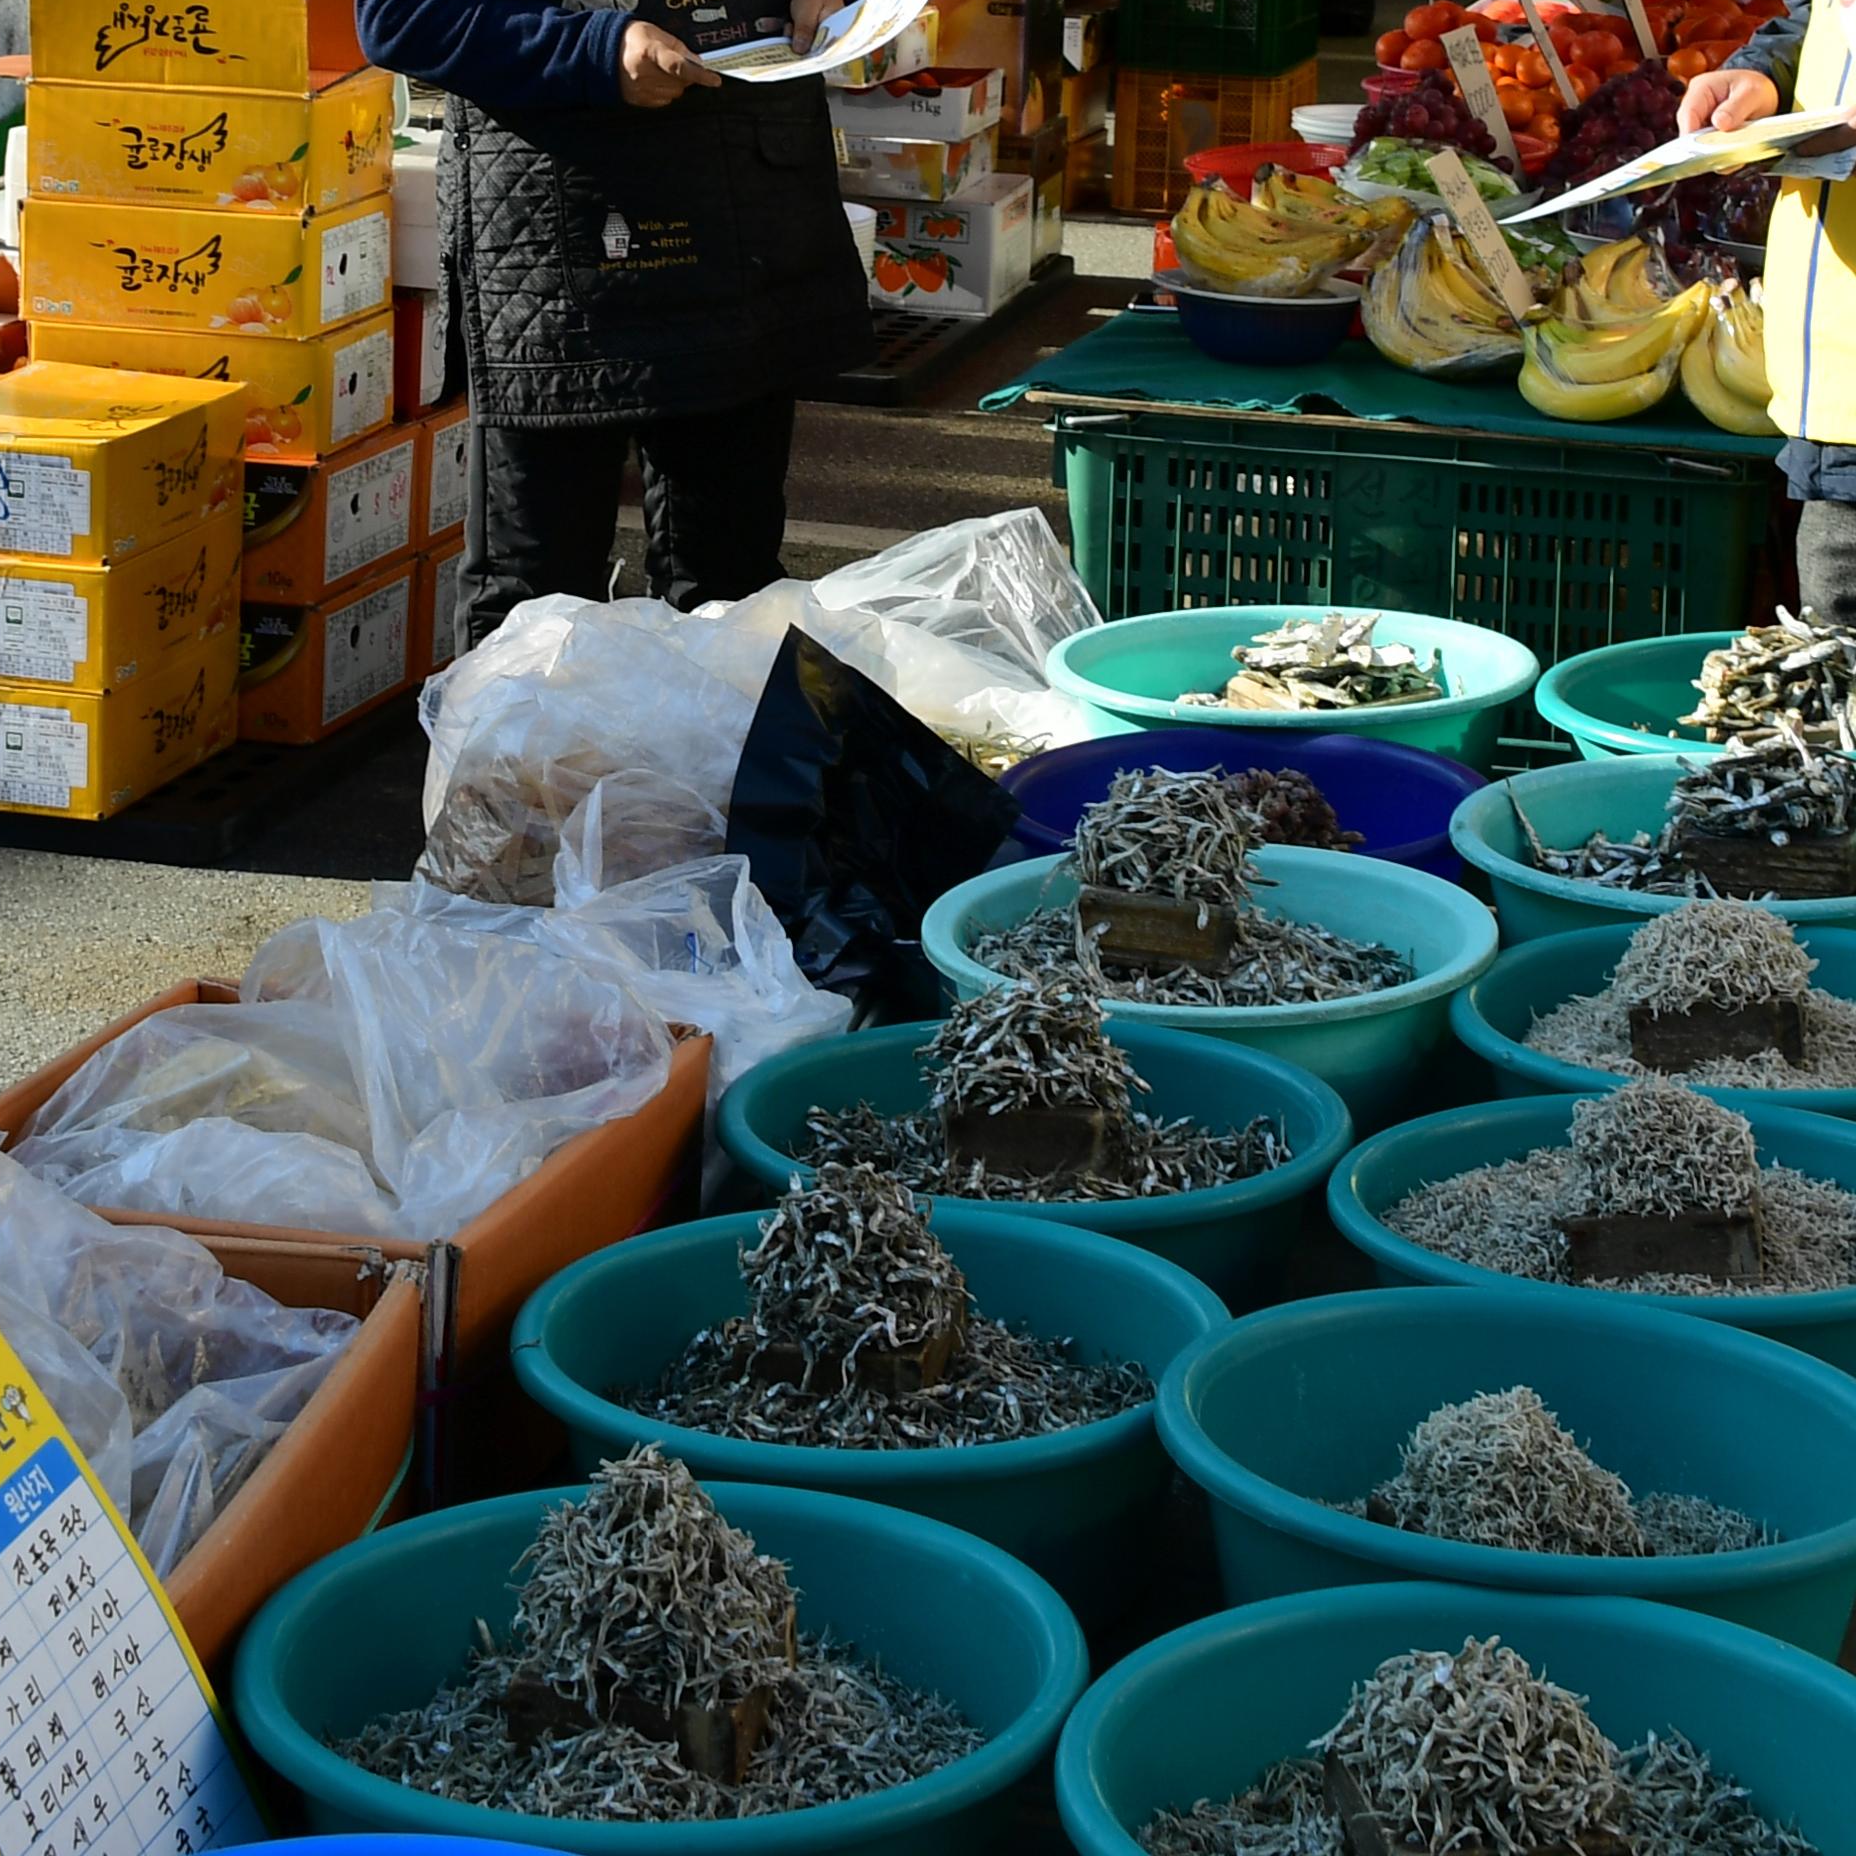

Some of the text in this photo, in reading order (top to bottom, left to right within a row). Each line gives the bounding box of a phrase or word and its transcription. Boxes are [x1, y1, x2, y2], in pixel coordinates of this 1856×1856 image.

[118, 126, 213, 173] 귤로장생
[637, 219, 665, 233] Wish
[112, 248, 206, 295] 귤로장생
[0, 1463, 56, 1525] 원산지
[12, 1529, 58, 1588] 전품목
[68, 1592, 123, 1660] 러시아
[91, 1634, 143, 1701] 러시아
[42, 1793, 111, 1856] 새우
